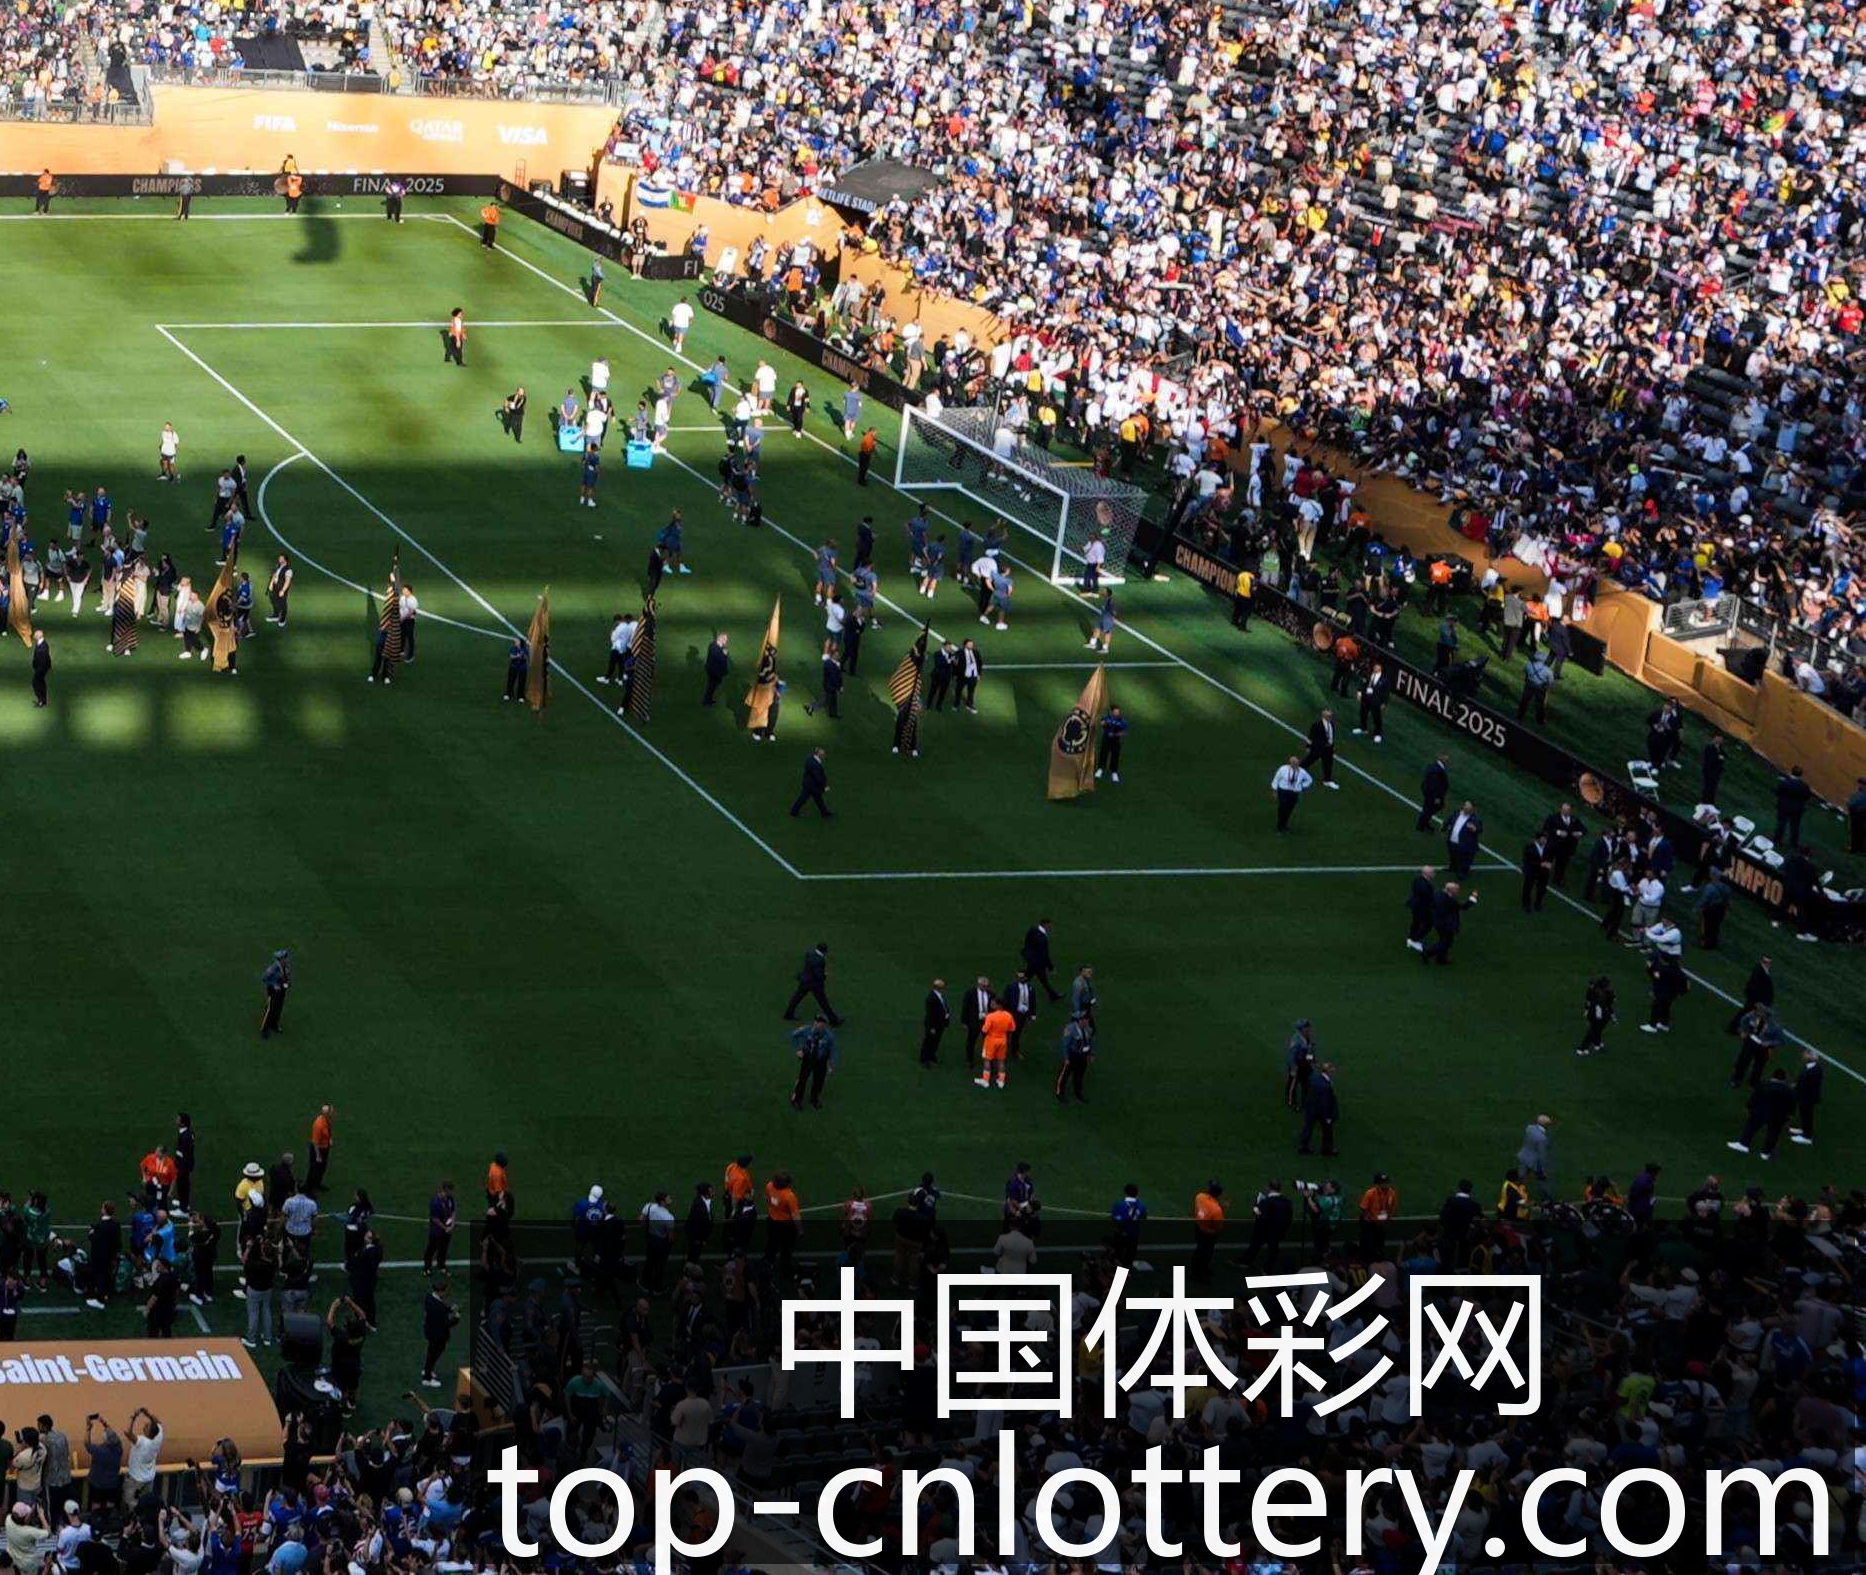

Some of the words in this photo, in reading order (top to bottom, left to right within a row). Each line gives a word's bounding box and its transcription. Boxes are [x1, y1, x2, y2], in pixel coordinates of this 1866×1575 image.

[496, 125, 549, 145] VISA
[406, 178, 445, 193] 2025
[1174, 544, 1238, 597] CHAMPION
[1395, 669, 1456, 723] FINAL
[1455, 706, 1508, 750] 2025
